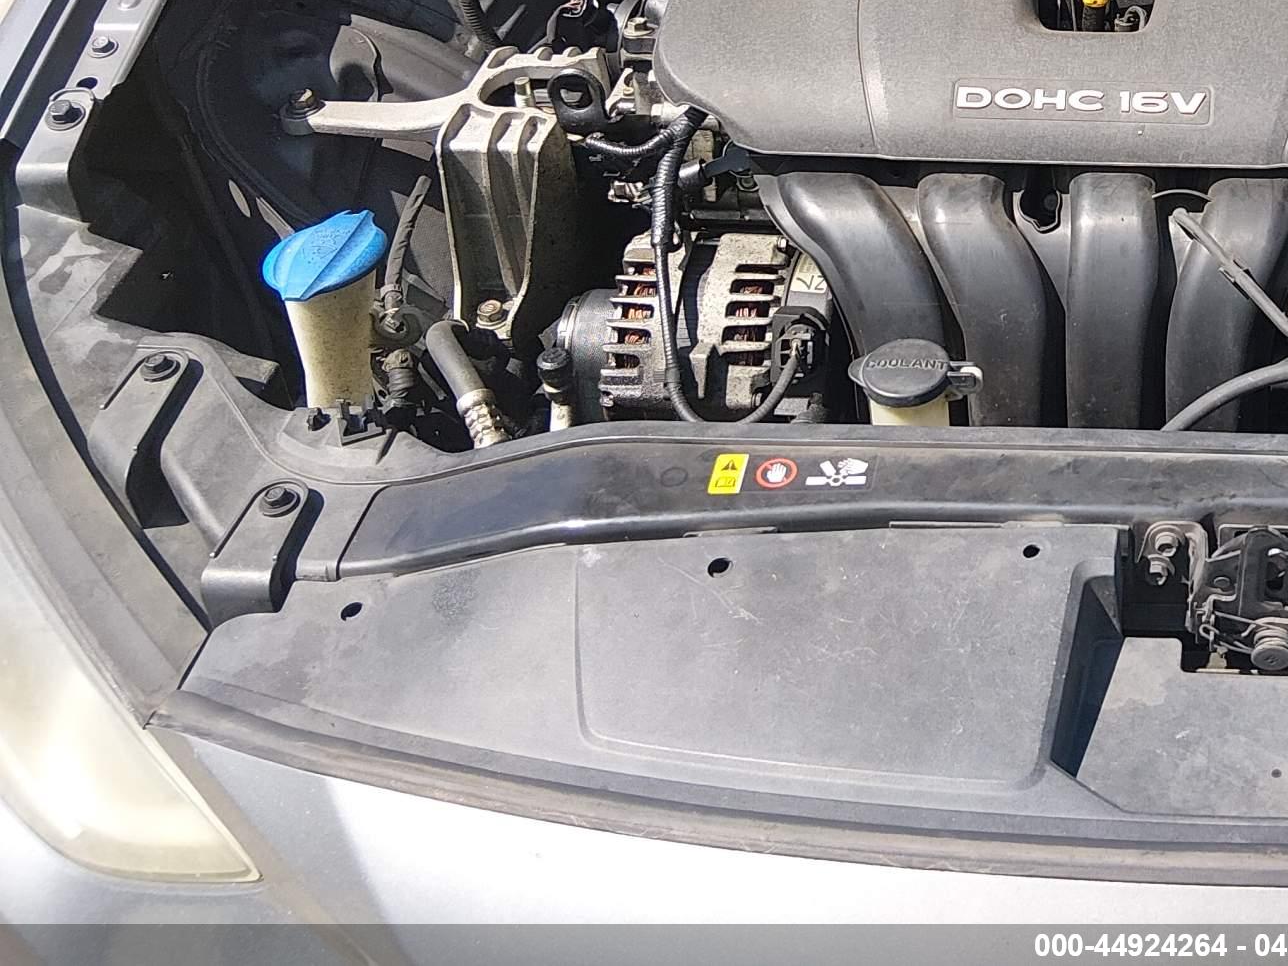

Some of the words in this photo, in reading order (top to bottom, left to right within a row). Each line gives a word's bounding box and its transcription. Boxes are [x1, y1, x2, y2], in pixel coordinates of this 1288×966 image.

[956, 86, 1105, 112] DOHC
[1119, 90, 1207, 115] 16V
[866, 358, 948, 371] COOLANT
